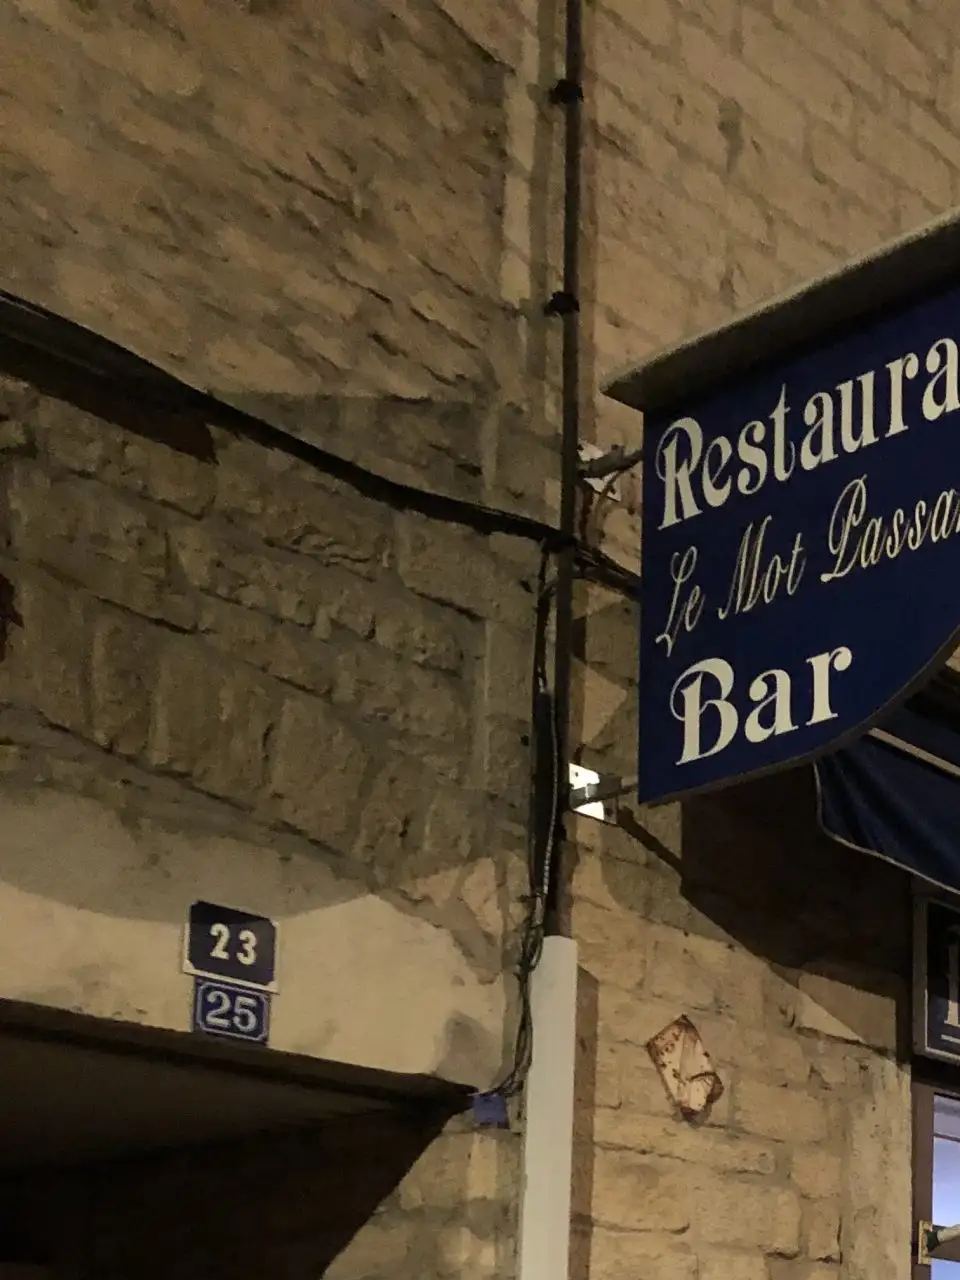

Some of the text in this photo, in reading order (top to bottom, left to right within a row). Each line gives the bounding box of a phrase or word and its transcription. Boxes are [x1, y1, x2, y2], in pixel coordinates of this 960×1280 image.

[656, 544, 705, 658] Le
[718, 513, 808, 620] Mot
[670, 646, 852, 767] Bar
[210, 923, 257, 965] 23
[206, 990, 257, 1032] 25
